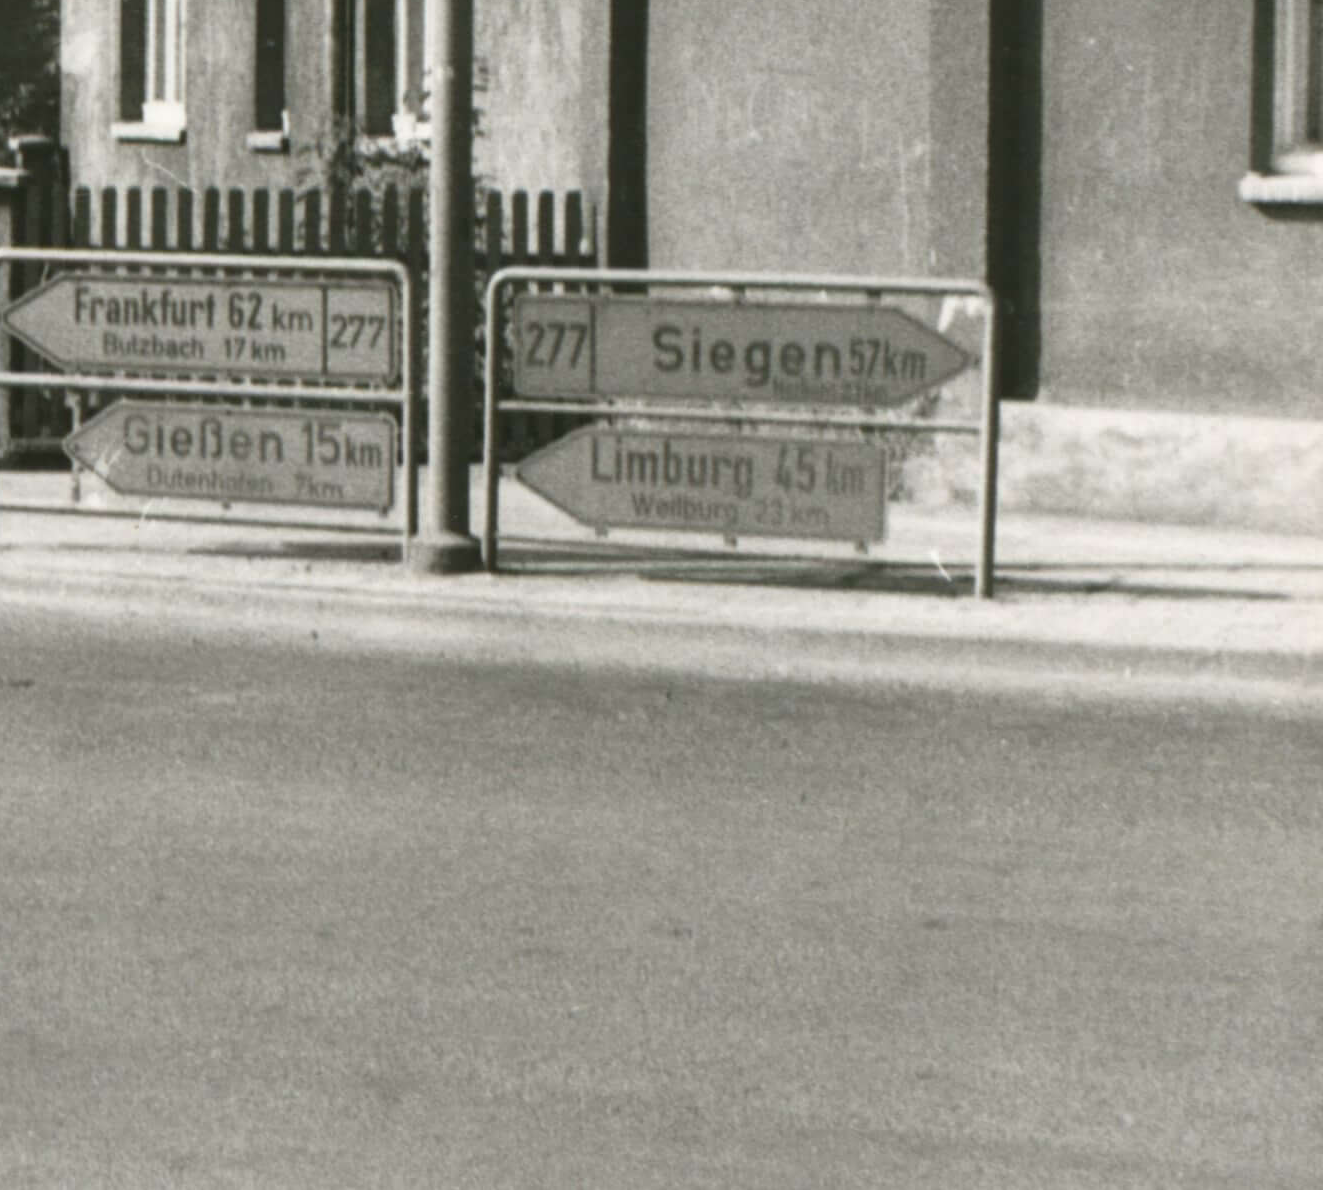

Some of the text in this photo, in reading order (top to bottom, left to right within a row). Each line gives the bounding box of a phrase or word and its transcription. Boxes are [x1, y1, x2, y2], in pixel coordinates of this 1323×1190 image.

[74, 286, 313, 332] Frankfurt 62 km
[330, 314, 386, 350] 277
[102, 331, 204, 360] Butzbach
[224, 337, 246, 359] 17
[526, 323, 588, 370] 277
[652, 324, 841, 388] Siegen
[123, 414, 284, 463] Gießen
[591, 434, 866, 499] Limburg 45 km
[630, 492, 740, 526] Weilburg
